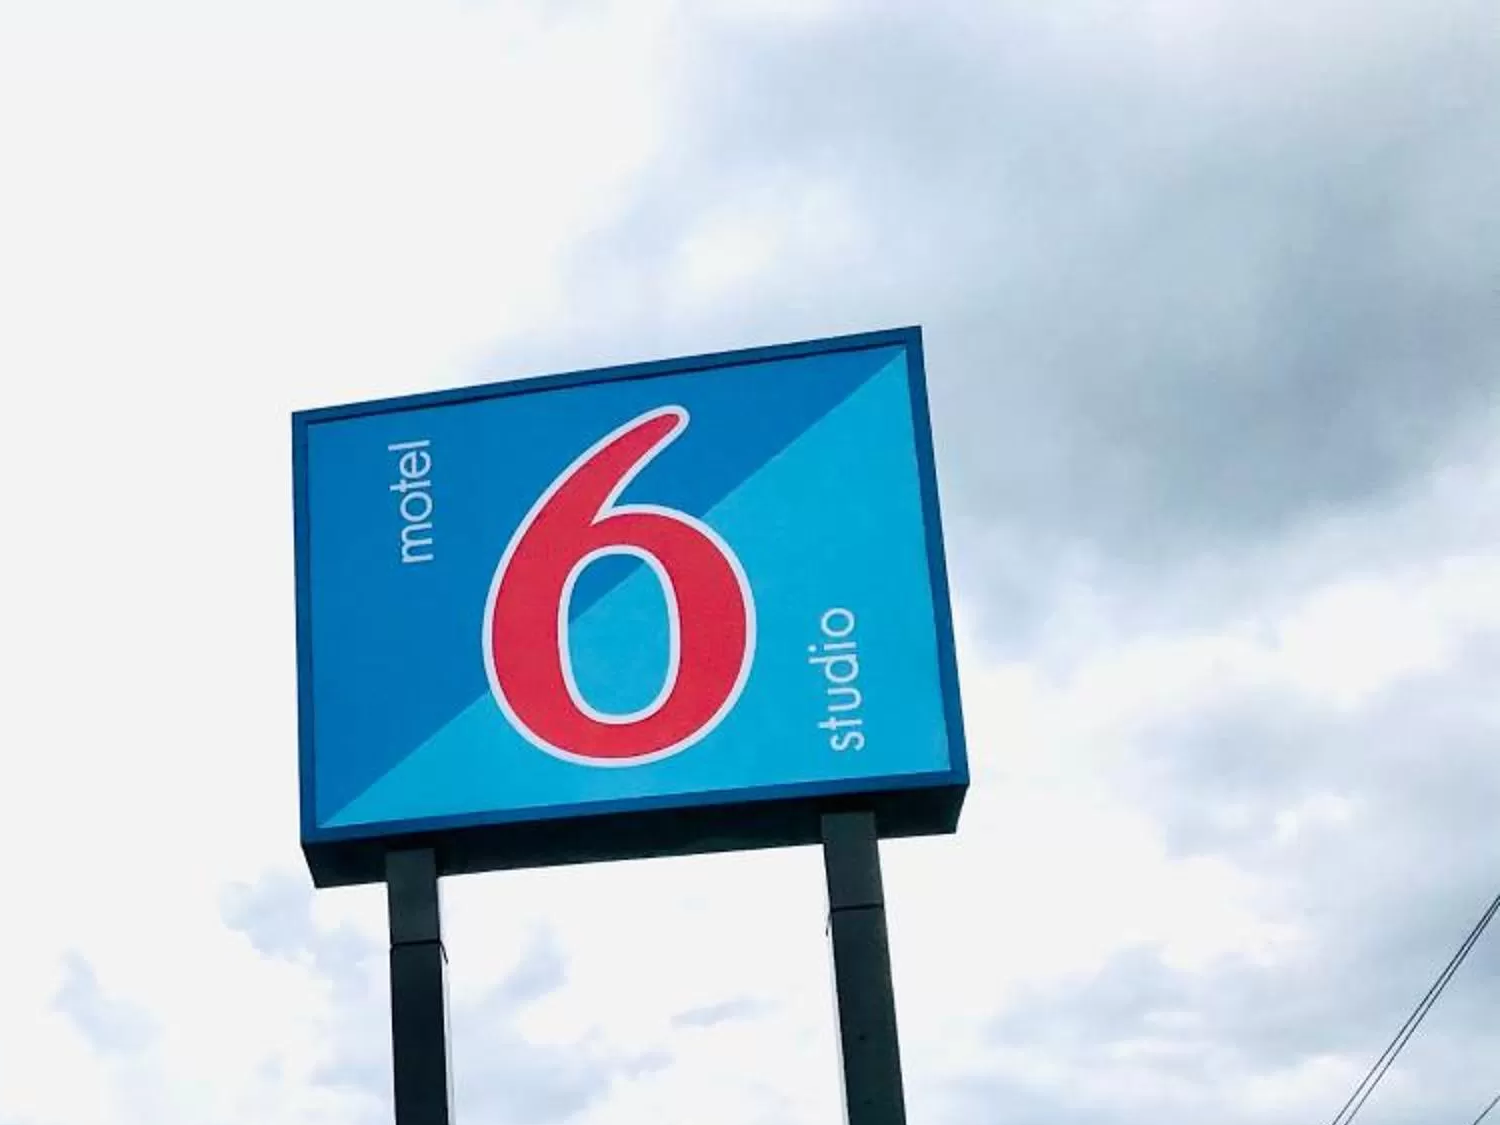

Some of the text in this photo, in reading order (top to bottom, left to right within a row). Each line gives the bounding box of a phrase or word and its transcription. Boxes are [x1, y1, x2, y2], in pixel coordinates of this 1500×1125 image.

[387, 440, 434, 563] motel
[482, 404, 757, 768] 6
[808, 607, 865, 751] studio
